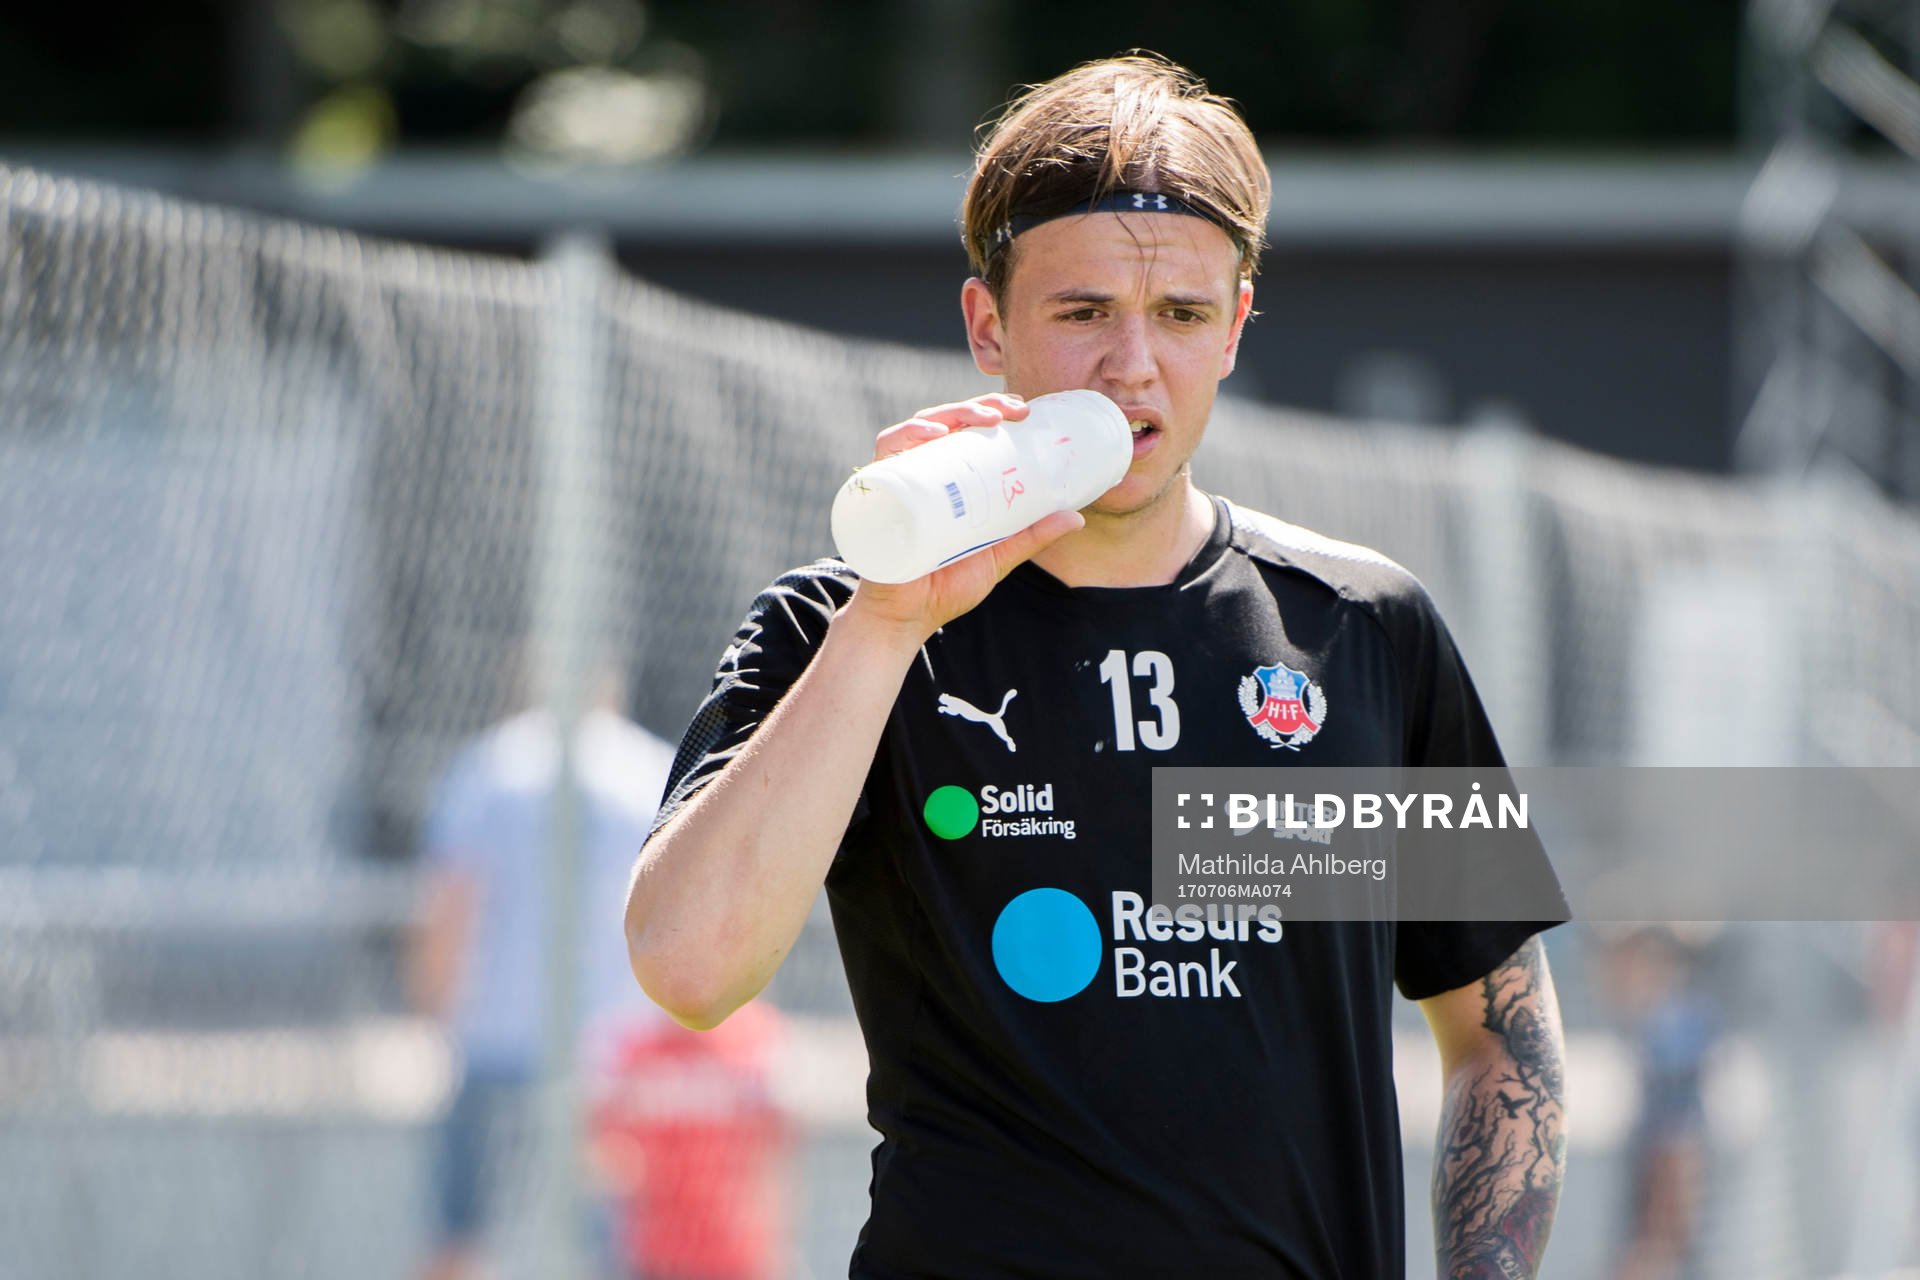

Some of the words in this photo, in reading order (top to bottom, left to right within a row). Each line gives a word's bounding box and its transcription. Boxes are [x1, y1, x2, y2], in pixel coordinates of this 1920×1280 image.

[1099, 649, 1181, 752] 13
[980, 783, 1054, 814] Solid
[982, 816, 1077, 840] Försäkring
[1111, 890, 1284, 943] Resurs
[1114, 947, 1242, 998] Bank
